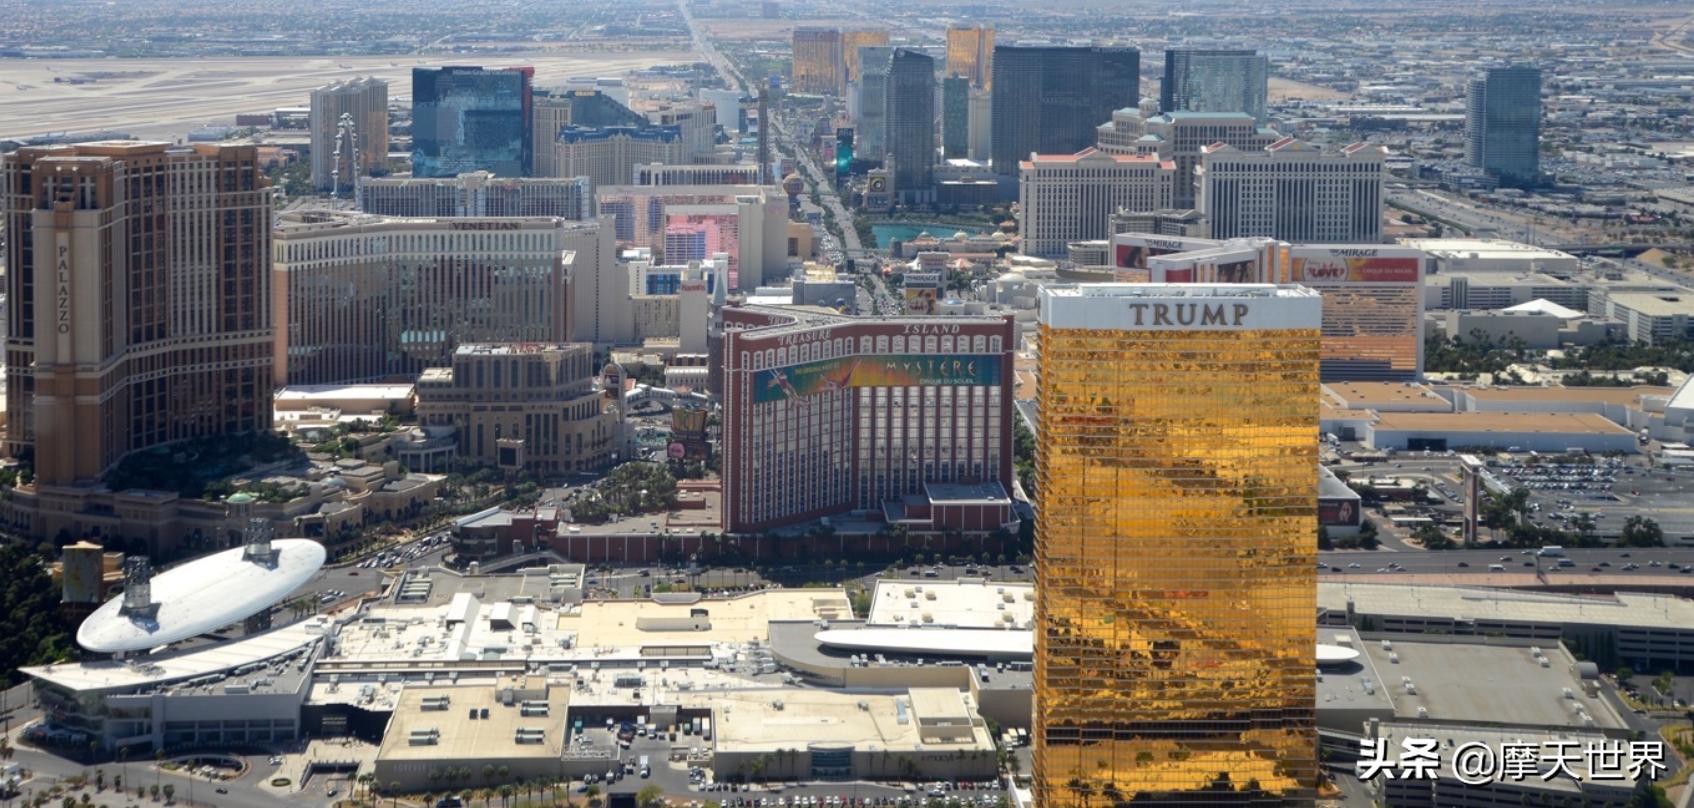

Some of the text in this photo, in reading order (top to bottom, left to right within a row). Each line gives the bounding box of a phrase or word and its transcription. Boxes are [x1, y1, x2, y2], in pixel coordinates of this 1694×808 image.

[452, 222, 519, 231] VENETIAN
[1153, 239, 1184, 249] MIRAGE
[1341, 249, 1378, 257] MIRAGE
[58, 246, 70, 334] PALAZZO
[1129, 303, 1249, 326] TRUMP
[778, 324, 961, 346] TREASURE ISLAND
